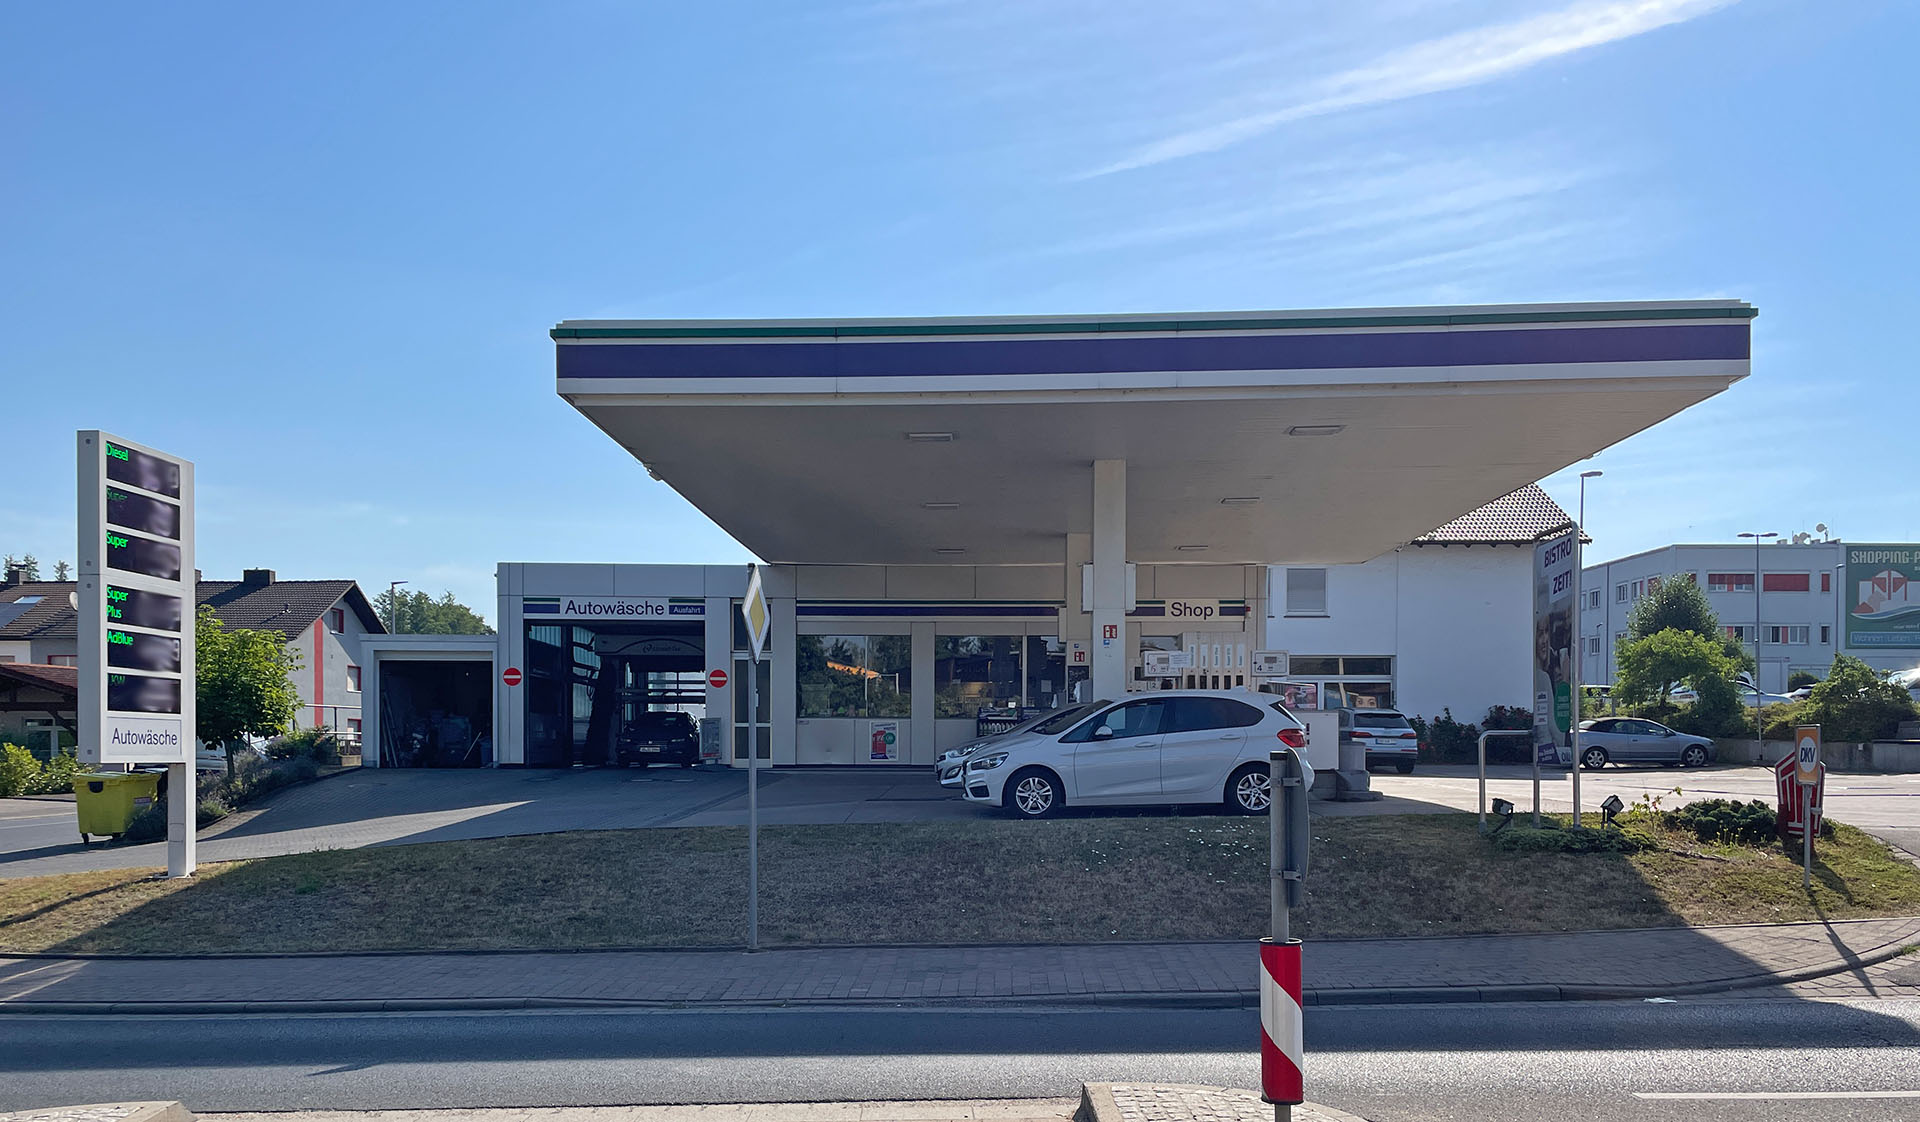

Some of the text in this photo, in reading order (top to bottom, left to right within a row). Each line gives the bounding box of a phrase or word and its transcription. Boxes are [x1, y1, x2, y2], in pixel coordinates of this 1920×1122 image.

[106, 443, 128, 461] Diesel
[106, 532, 128, 548] Super
[1544, 538, 1572, 568] BISTRO
[1553, 569, 1572, 595] ZEIT!
[106, 586, 128, 602] Super
[106, 605, 122, 619] Plus
[565, 600, 664, 616] Autowäsche
[673, 606, 701, 615] Ausfahrt
[1171, 602, 1214, 620] Shop
[107, 631, 134, 646] AdBlue
[1256, 664, 1263, 672] 4
[112, 728, 178, 746] Autowäsche
[1800, 747, 1816, 763] DKV
